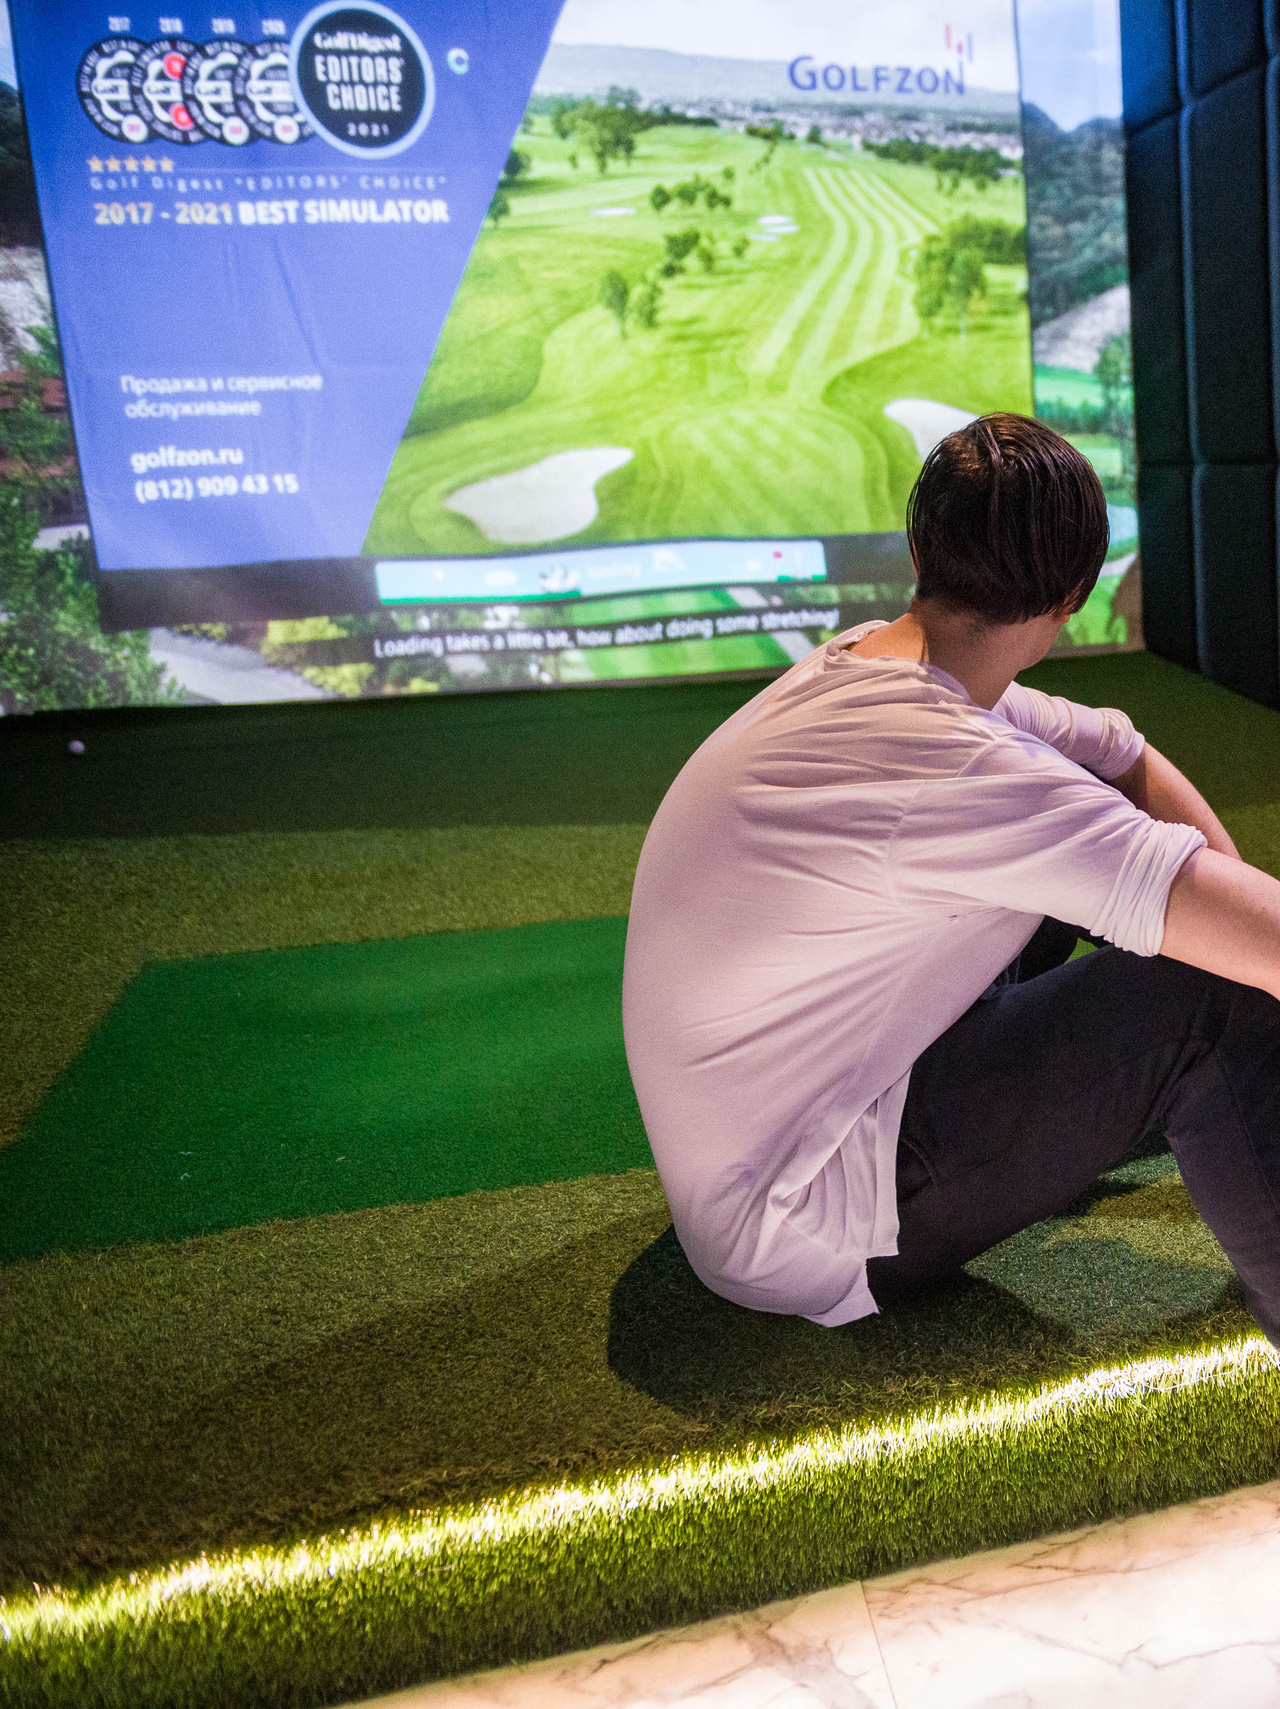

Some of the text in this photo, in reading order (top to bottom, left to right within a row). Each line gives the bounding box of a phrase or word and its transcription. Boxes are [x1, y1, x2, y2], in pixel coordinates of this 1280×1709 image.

[787, 54, 965, 96] GOLFZON
[326, 83, 402, 112] CHOICE
[347, 122, 390, 137] 2021
[94, 201, 153, 225] 2017
[174, 201, 233, 225] 2021
[237, 200, 299, 225] BEST
[303, 199, 450, 224] SIMULATOR
[120, 374, 323, 397] Продажа и сервисное
[124, 398, 262, 421] обслуживание
[130, 445, 244, 474] golfzon.ru
[135, 472, 299, 504] (812) 909 43 15
[374, 634, 444, 659] Loading
[446, 632, 491, 651] takes
[493, 634, 506, 651] a
[506, 630, 544, 650] little
[576, 628, 613, 647] how
[614, 622, 663, 645] about
[666, 616, 713, 640] doing
[716, 614, 759, 634] some
